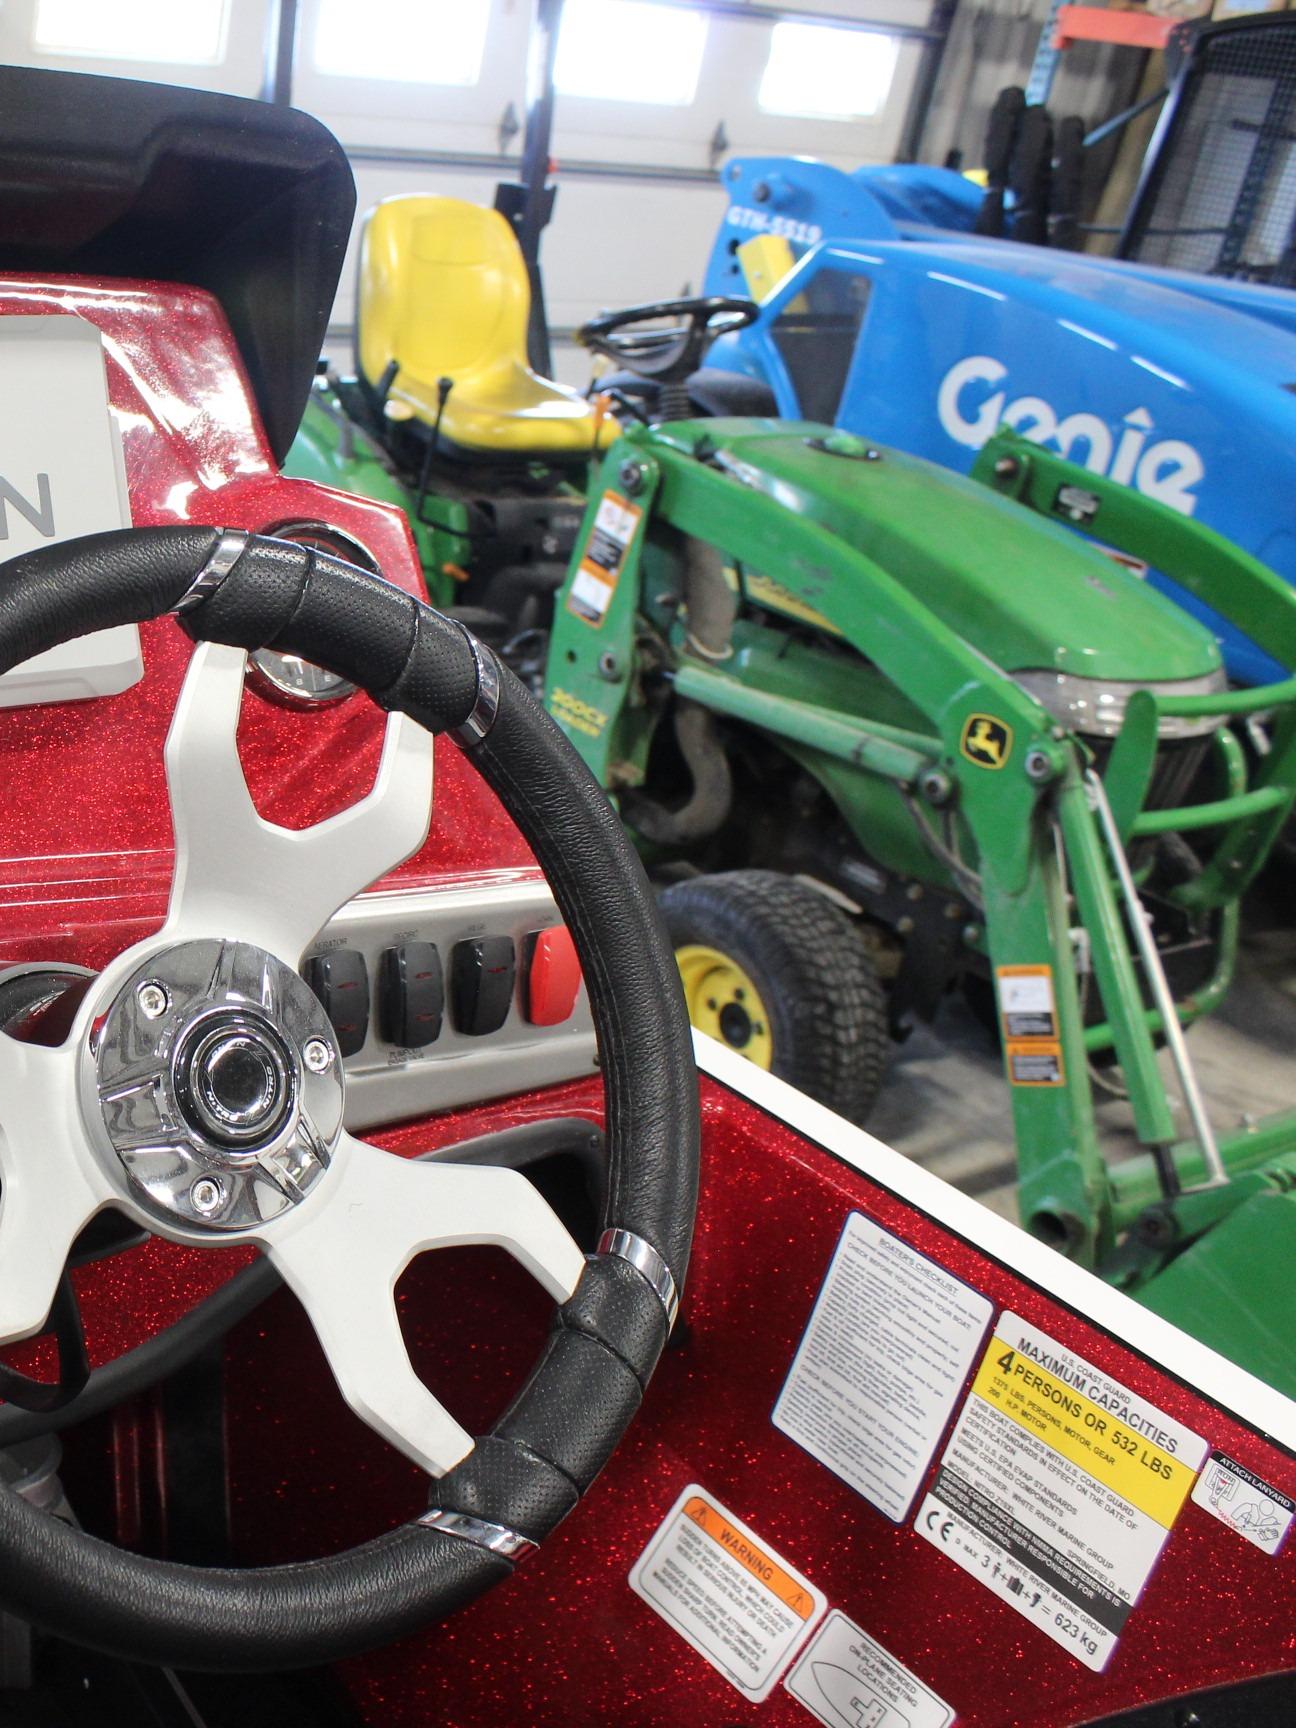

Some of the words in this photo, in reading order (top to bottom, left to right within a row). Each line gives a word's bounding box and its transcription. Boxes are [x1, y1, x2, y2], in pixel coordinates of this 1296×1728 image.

[1016, 1336, 1086, 1392] MAXIMUM
[1085, 1383, 1179, 1455] CAPACITIES
[1059, 1353, 1075, 1368] U.S.
[1075, 1363, 1103, 1386] COAST
[1101, 1380, 1132, 1406] GUARD
[996, 1350, 1014, 1375] 4
[1012, 1363, 1083, 1420] PERSONS
[1081, 1410, 1108, 1437] OR
[1109, 1429, 1139, 1458] 532
[1140, 1449, 1175, 1482] LBS
[1219, 1455, 1252, 1482] ATTACH
[1251, 1477, 1291, 1508] LANYARD
[718, 1527, 775, 1582] WARNING
[979, 1552, 992, 1570] 3
[1052, 1610, 1081, 1641] 623
[1078, 1630, 1100, 1657] kg
[856, 1663, 899, 1703] LOCATIONS
[859, 1641, 917, 1695] RECOMMENDED
